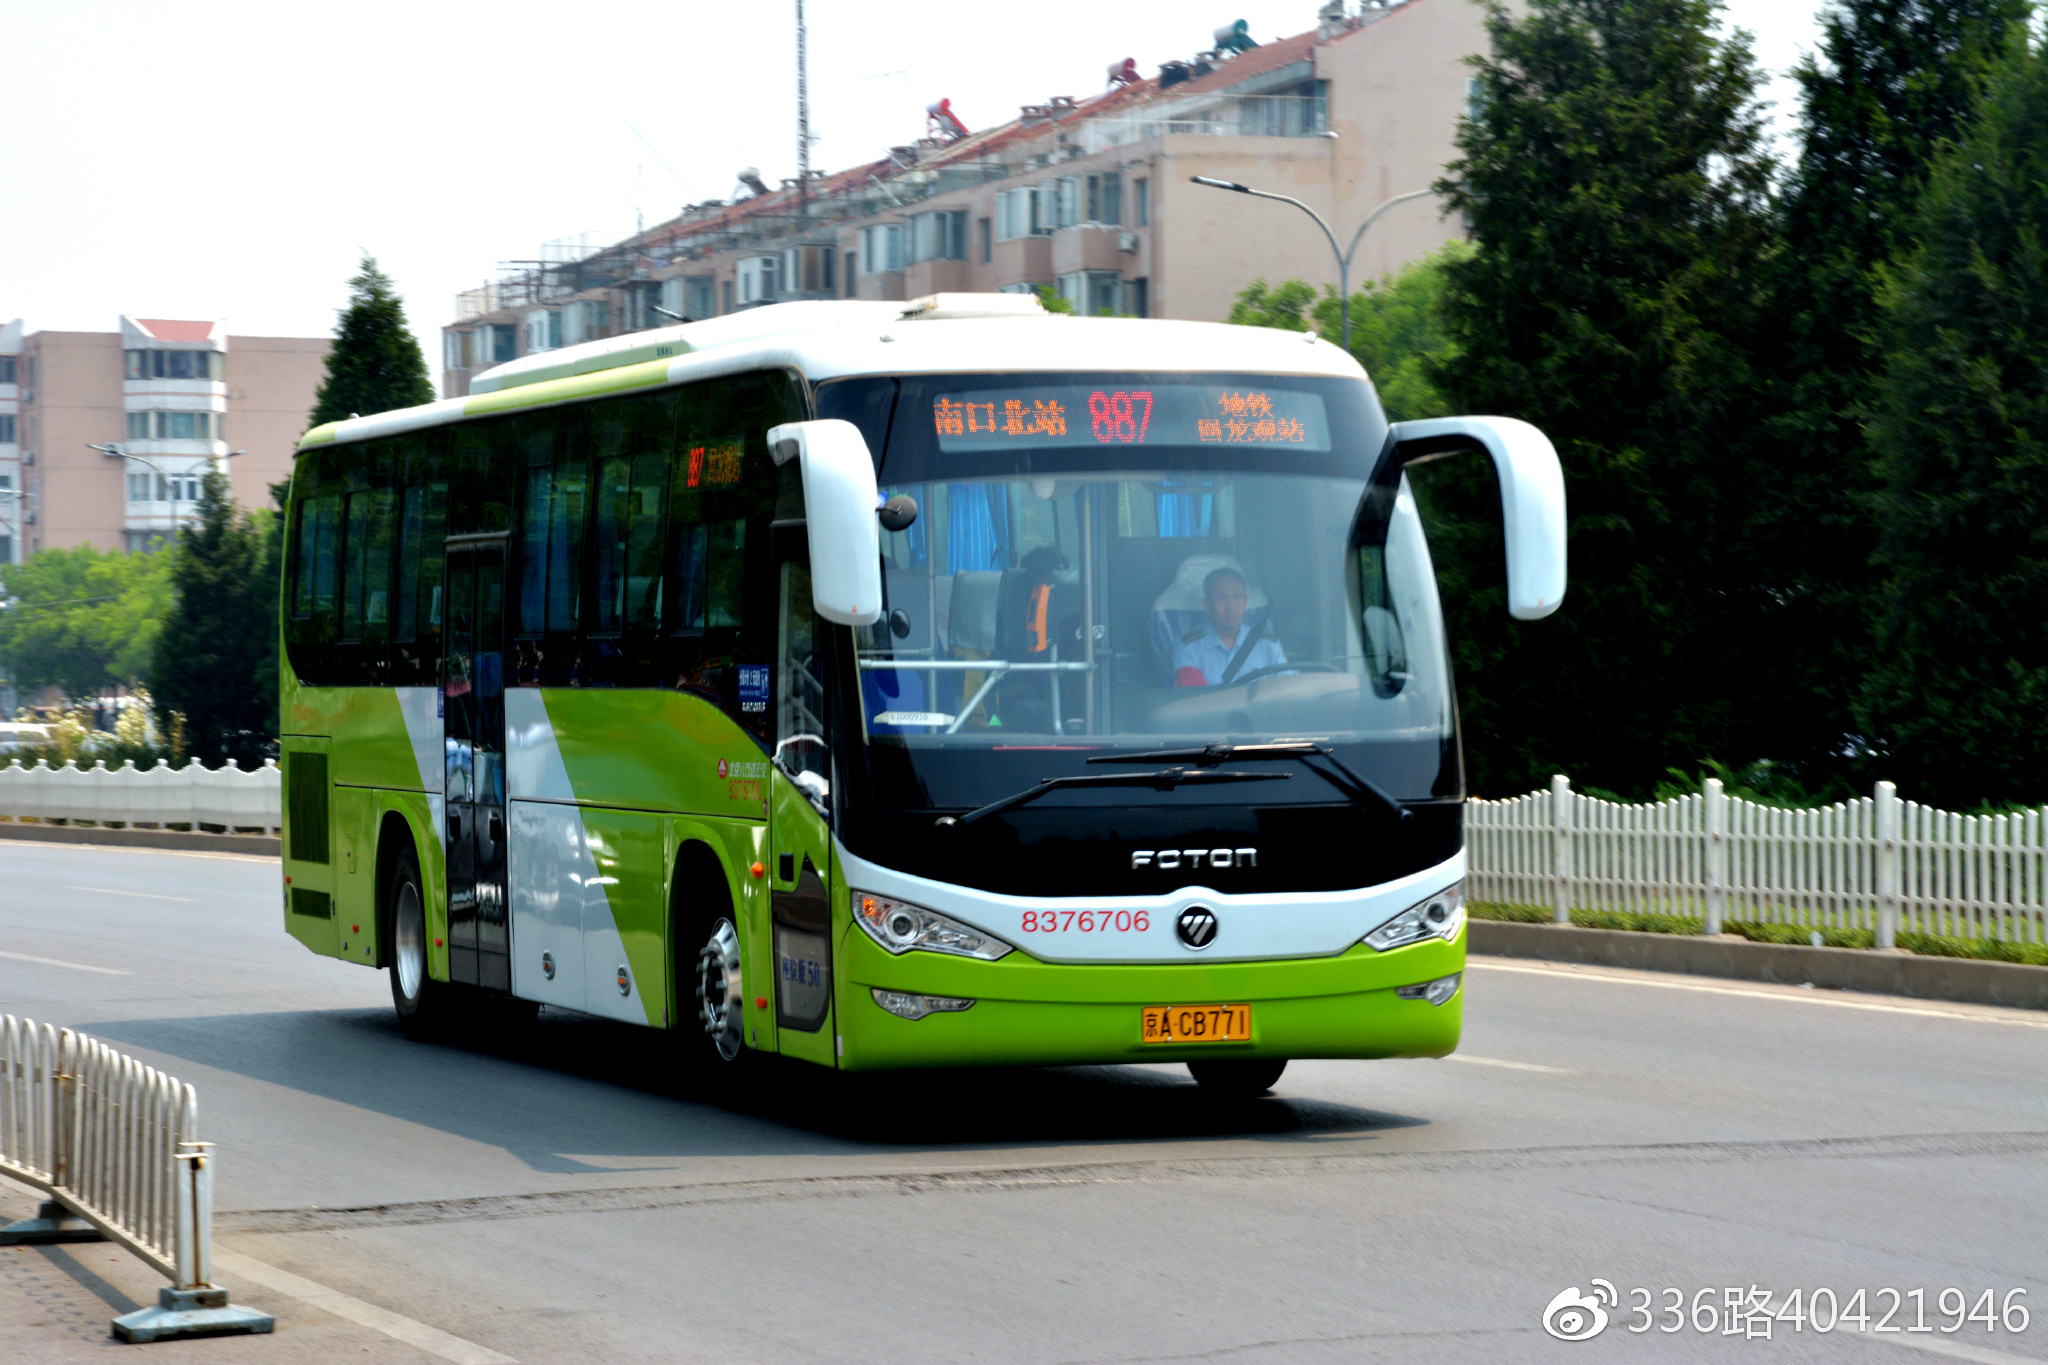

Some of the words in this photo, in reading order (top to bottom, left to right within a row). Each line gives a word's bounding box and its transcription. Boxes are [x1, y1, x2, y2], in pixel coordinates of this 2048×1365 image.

[933, 397, 1067, 436] 南口北站
[1088, 391, 1154, 443] 887
[1217, 392, 1275, 418] 地铁
[1197, 417, 1304, 443] 回龙观站
[687, 446, 705, 488] 887
[729, 779, 762, 801] 8376706
[1131, 848, 1258, 869] FOTON
[1021, 910, 1150, 932] 8376706
